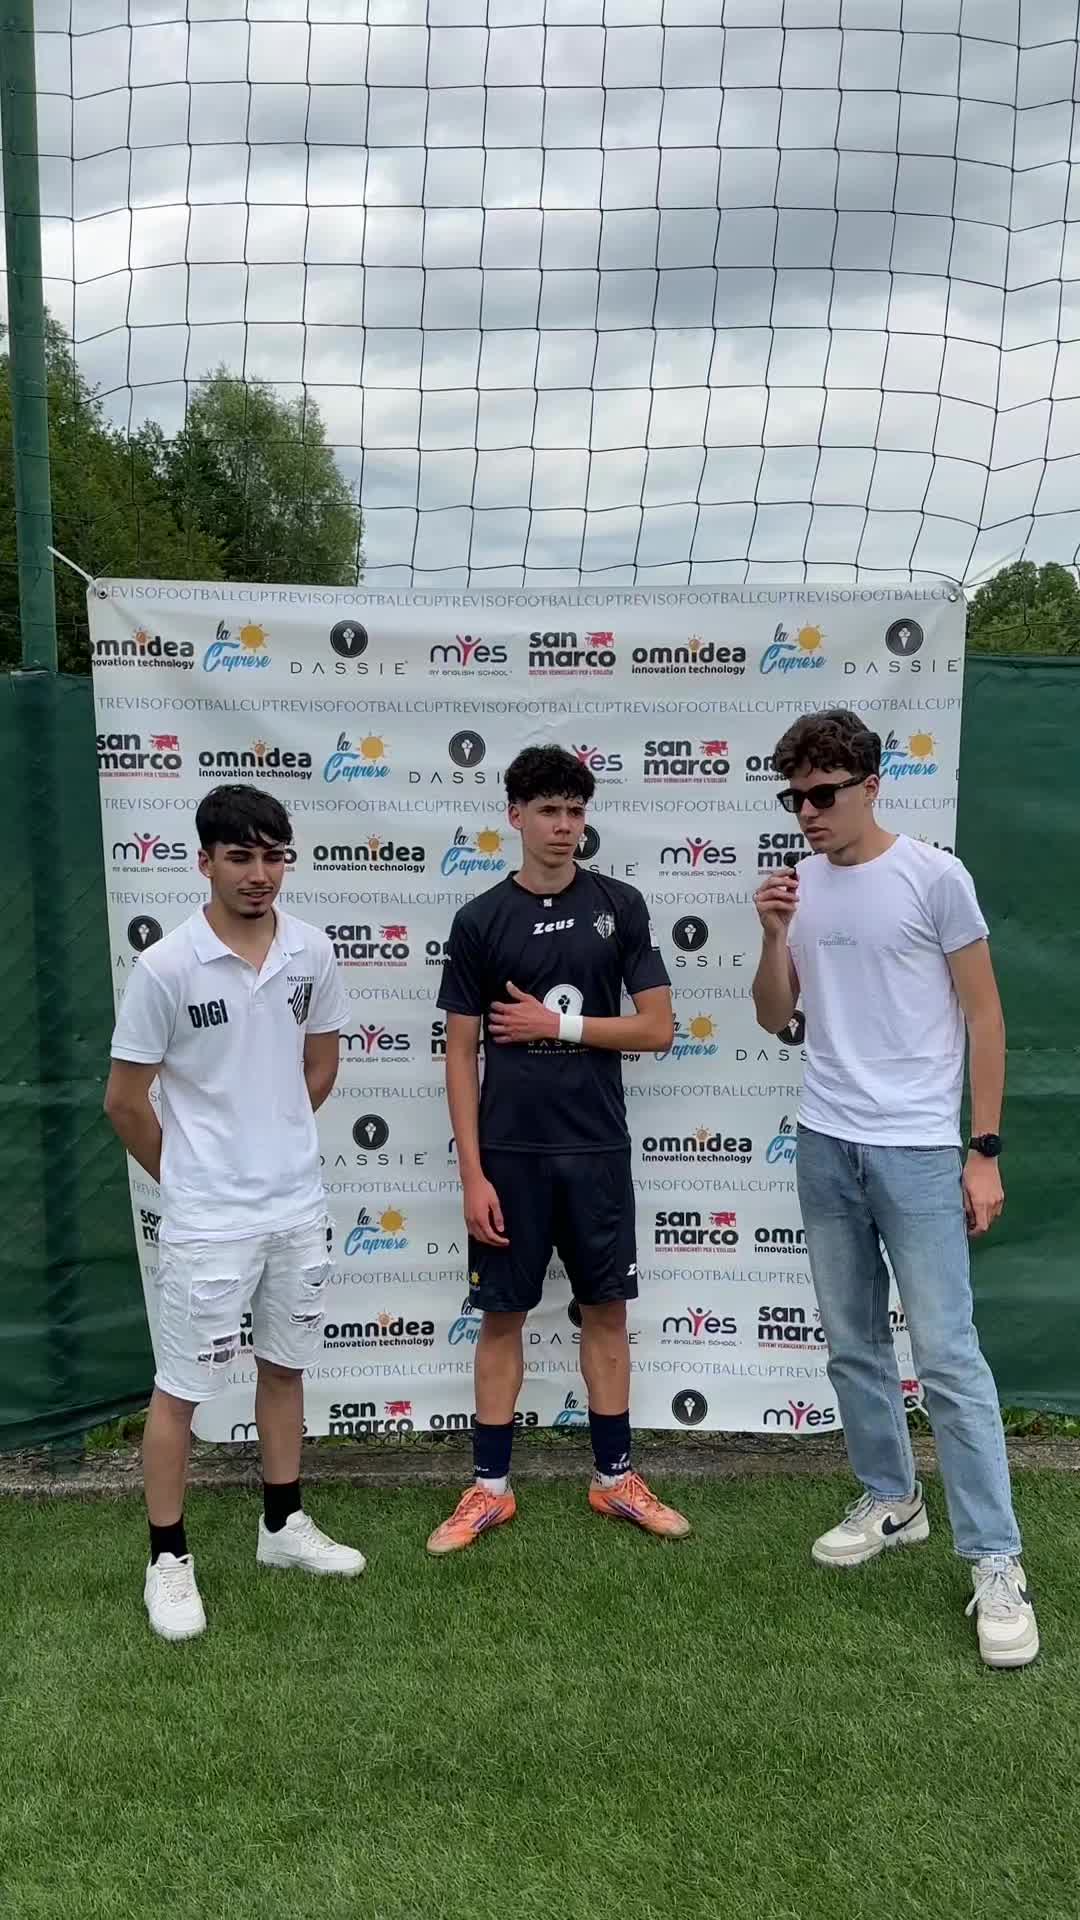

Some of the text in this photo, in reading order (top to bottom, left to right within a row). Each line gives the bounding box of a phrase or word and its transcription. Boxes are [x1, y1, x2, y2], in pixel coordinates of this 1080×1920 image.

[216, 620, 231, 641] la
[774, 623, 789, 642] la
[529, 632, 577, 648] san
[203, 642, 272, 672] Caprese
[529, 650, 616, 667] marco
[632, 642, 746, 663] omnidea
[760, 644, 827, 674] Caprese
[137, 659, 194, 670] technology
[290, 661, 405, 675] DASSIE
[632, 664, 746, 675] innovation technology
[844, 659, 958, 674] DASSIE
[96, 734, 141, 750] san
[337, 732, 351, 751] la
[644, 740, 691, 757] san
[885, 730, 899, 750] la
[97, 753, 182, 769] marco
[198, 748, 312, 768] omnidea
[199, 769, 312, 780] innovation technology
[324, 754, 391, 783] Caprese
[643, 759, 730, 776] marco
[409, 772, 500, 784] DASSI
[454, 826, 468, 846] la
[758, 833, 804, 849] san
[313, 841, 425, 861] omnidea
[313, 862, 425, 873] innovation technology
[441, 847, 505, 876] Caprese
[325, 925, 371, 941] san
[533, 918, 575, 935] Zeus
[188, 999, 228, 1028] DIGI
[779, 1115, 793, 1134] la
[642, 1132, 752, 1152] omnidea
[642, 1153, 752, 1163] innovation technology
[357, 1207, 371, 1226] la
[655, 1211, 701, 1227] san
[344, 1227, 408, 1256] Caprese
[655, 1228, 739, 1246] marco
[754, 1246, 808, 1254] innovation
[758, 1306, 805, 1323] san
[324, 1317, 434, 1338] omnidea
[758, 1324, 825, 1343] marc
[324, 1337, 434, 1349] innovation technology
[564, 1391, 578, 1409] la
[329, 1402, 376, 1418] san
